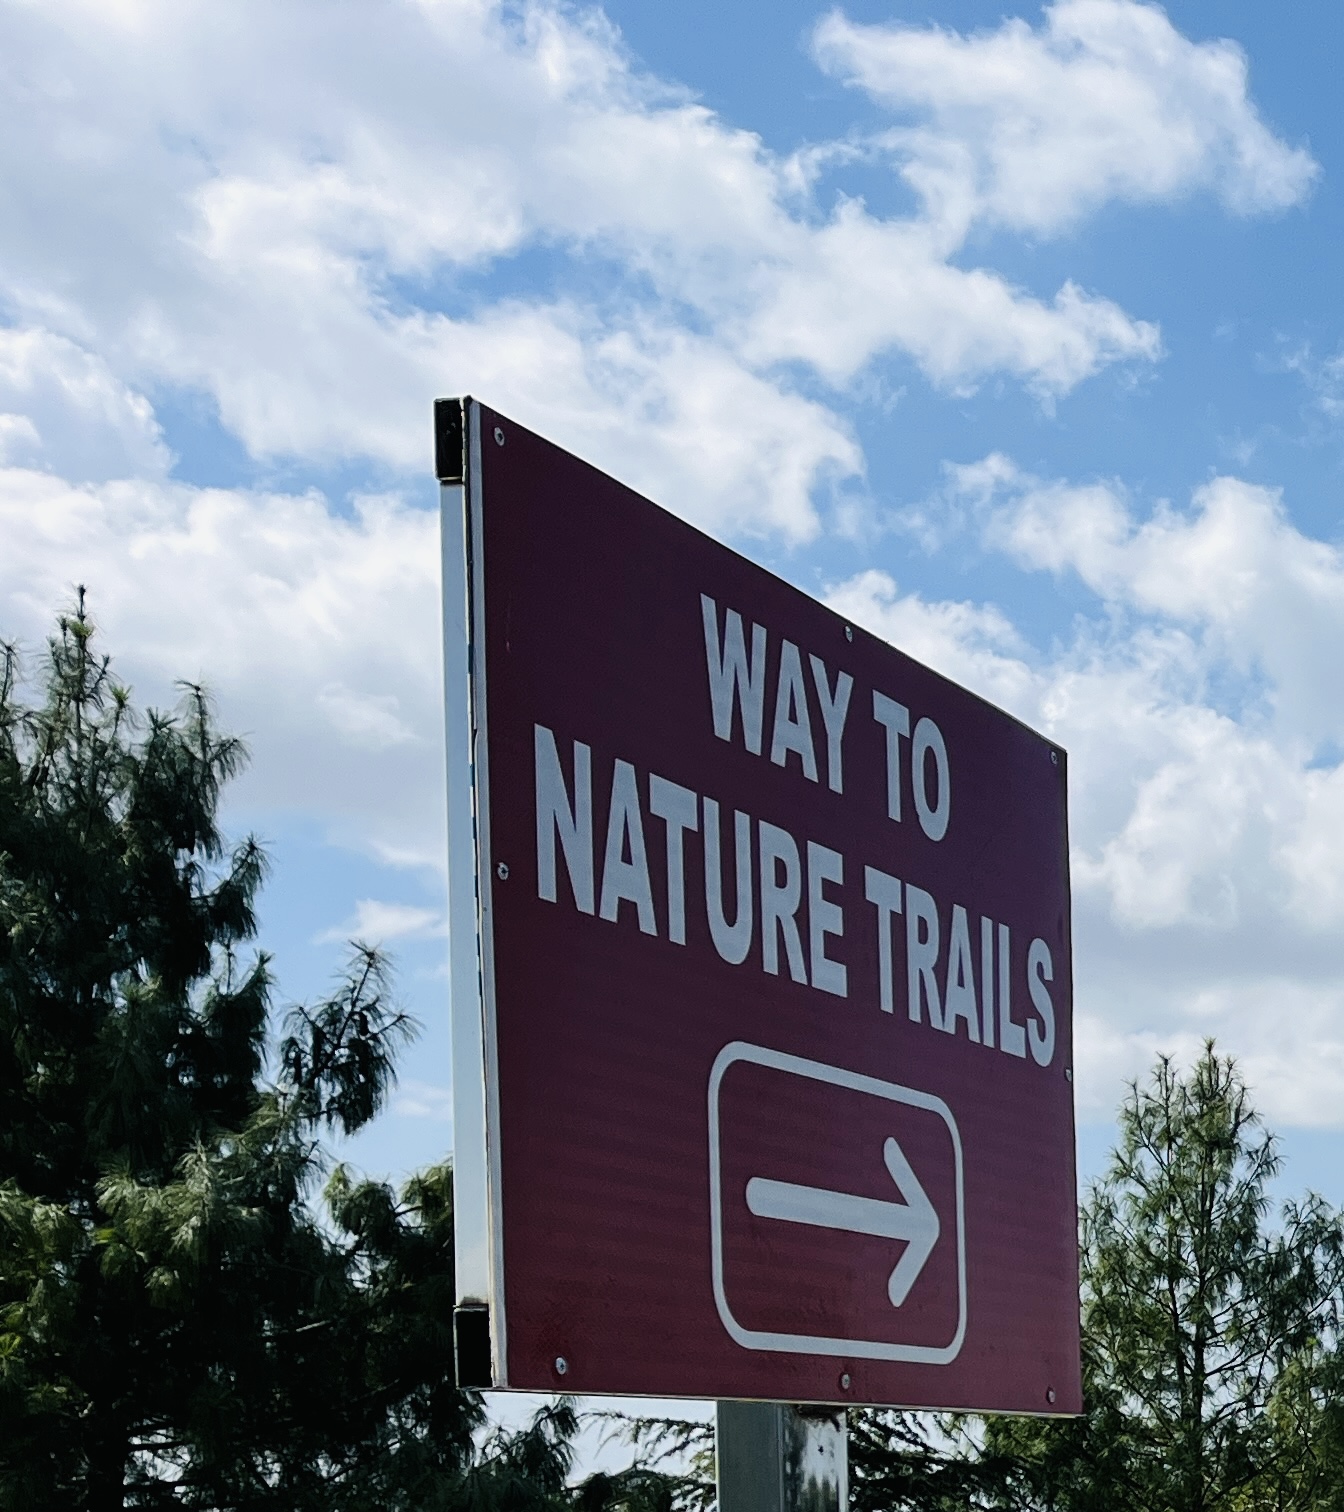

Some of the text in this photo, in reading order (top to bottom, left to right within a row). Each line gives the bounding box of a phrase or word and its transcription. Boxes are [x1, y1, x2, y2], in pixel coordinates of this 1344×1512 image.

[699, 593, 951, 842] WAY TO
[533, 723, 1056, 1068] NATURE TRAILS
